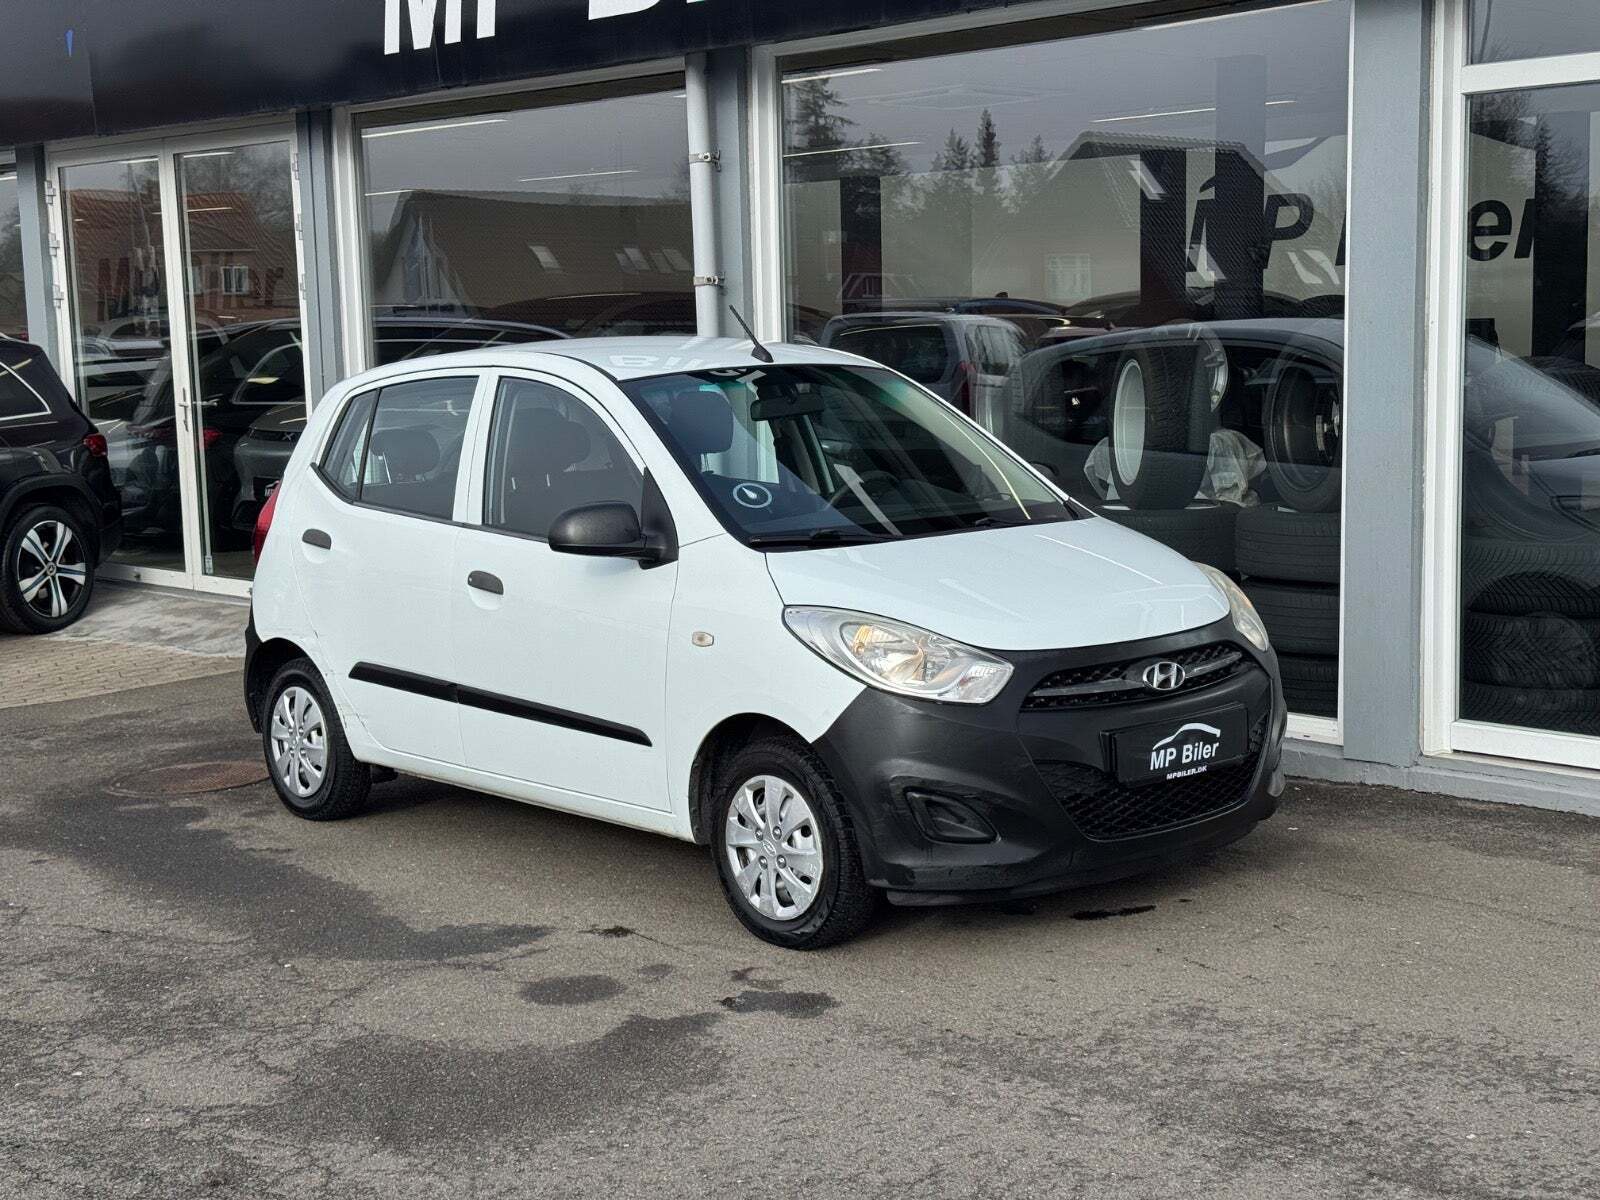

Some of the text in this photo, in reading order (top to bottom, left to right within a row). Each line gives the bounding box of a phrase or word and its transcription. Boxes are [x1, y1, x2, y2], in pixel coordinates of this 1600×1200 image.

[1150, 741, 1219, 770] MP Biler
[1166, 765, 1208, 780] MPBILER.DK
